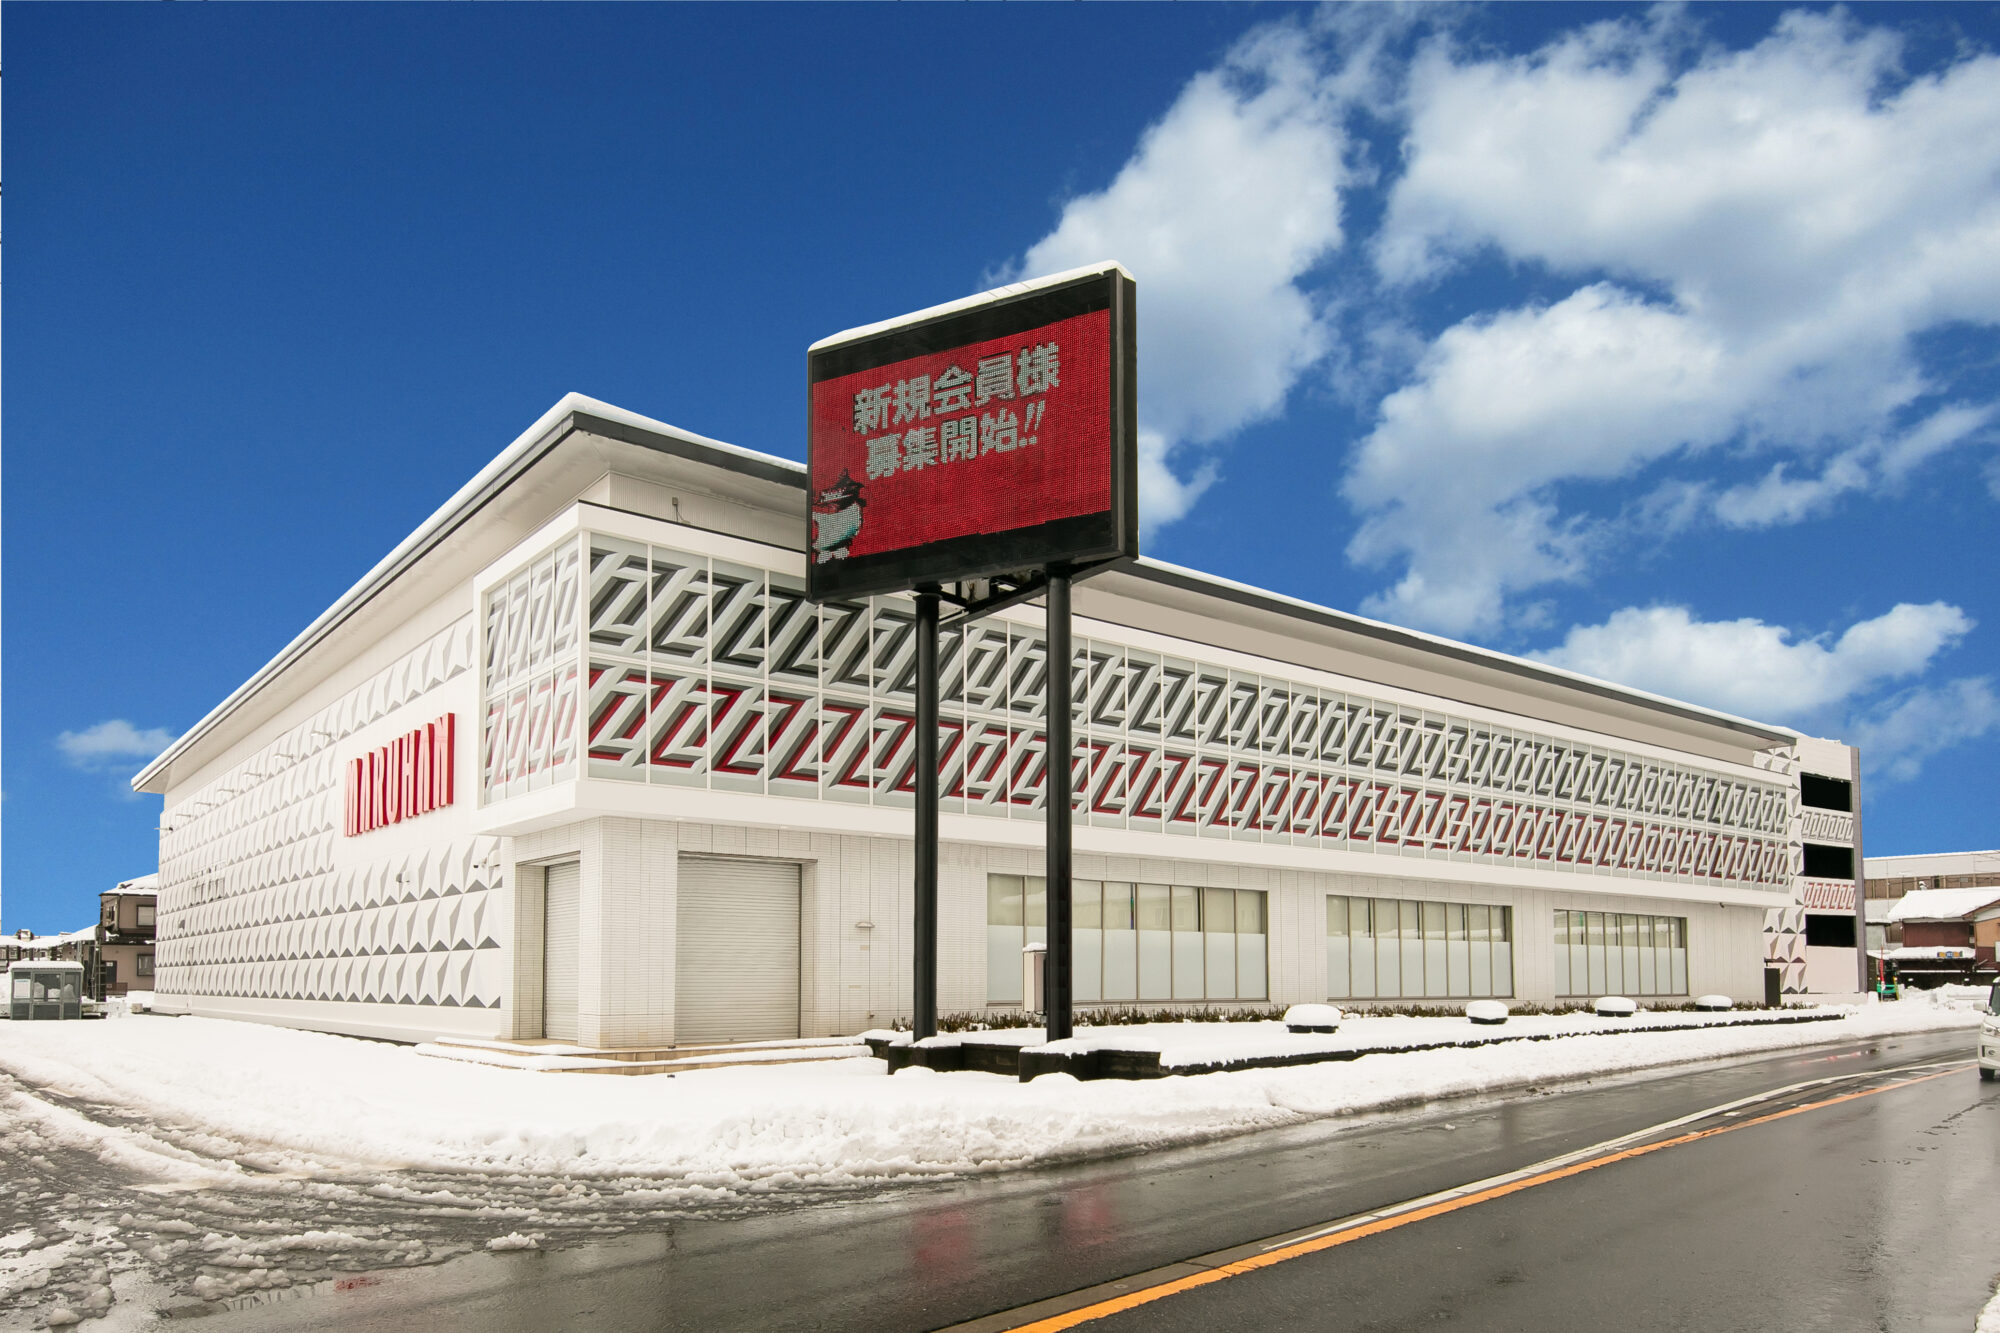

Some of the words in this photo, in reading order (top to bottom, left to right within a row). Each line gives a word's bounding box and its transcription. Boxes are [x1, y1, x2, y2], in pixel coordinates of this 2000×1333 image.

[853, 341, 1061, 435] 新規会員様
[344, 712, 455, 838] MARUHAN
